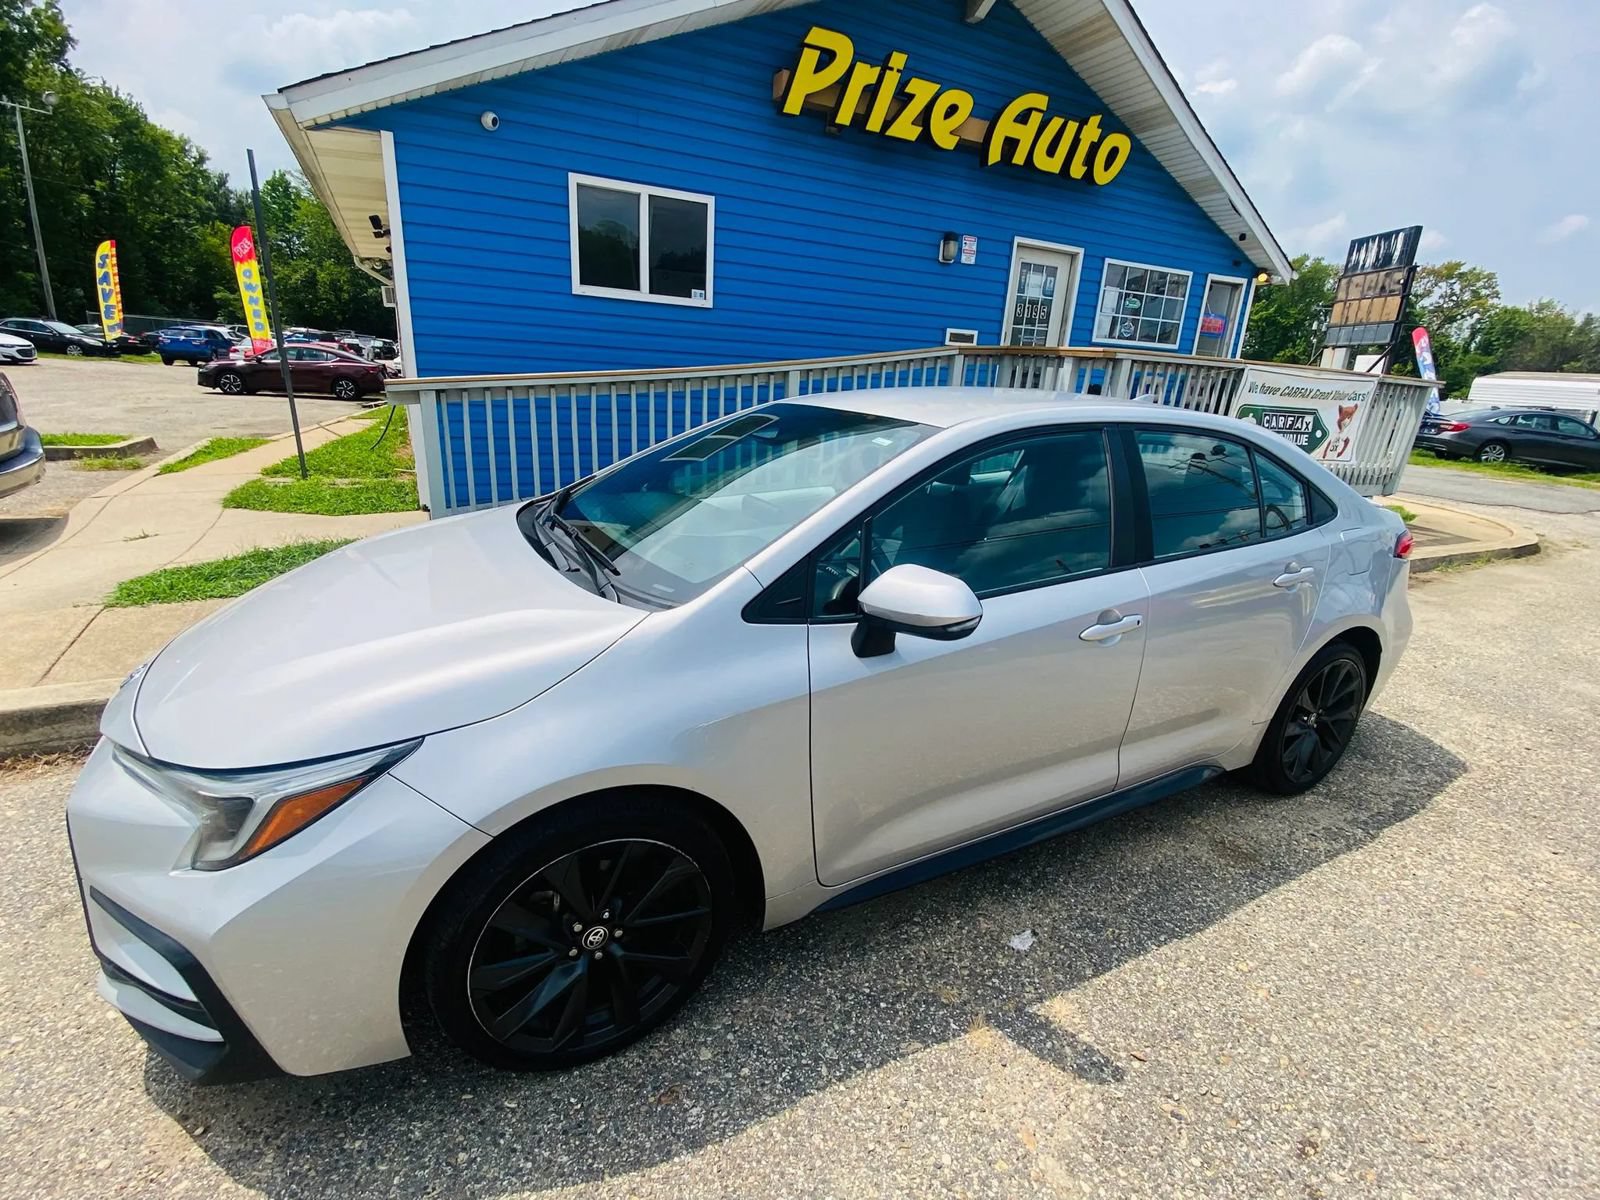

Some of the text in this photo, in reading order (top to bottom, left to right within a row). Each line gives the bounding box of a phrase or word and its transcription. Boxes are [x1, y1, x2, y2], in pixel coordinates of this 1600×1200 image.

[783, 26, 1132, 186] Prize Auto
[98, 253, 117, 320] SAVE
[1016, 303, 1047, 320] 3195
[1248, 381, 1259, 394] We
[1259, 382, 1281, 396] have
[1280, 386, 1314, 399] CARFAX
[1310, 388, 1333, 401] Great
[1263, 413, 1313, 432] CARFAX
